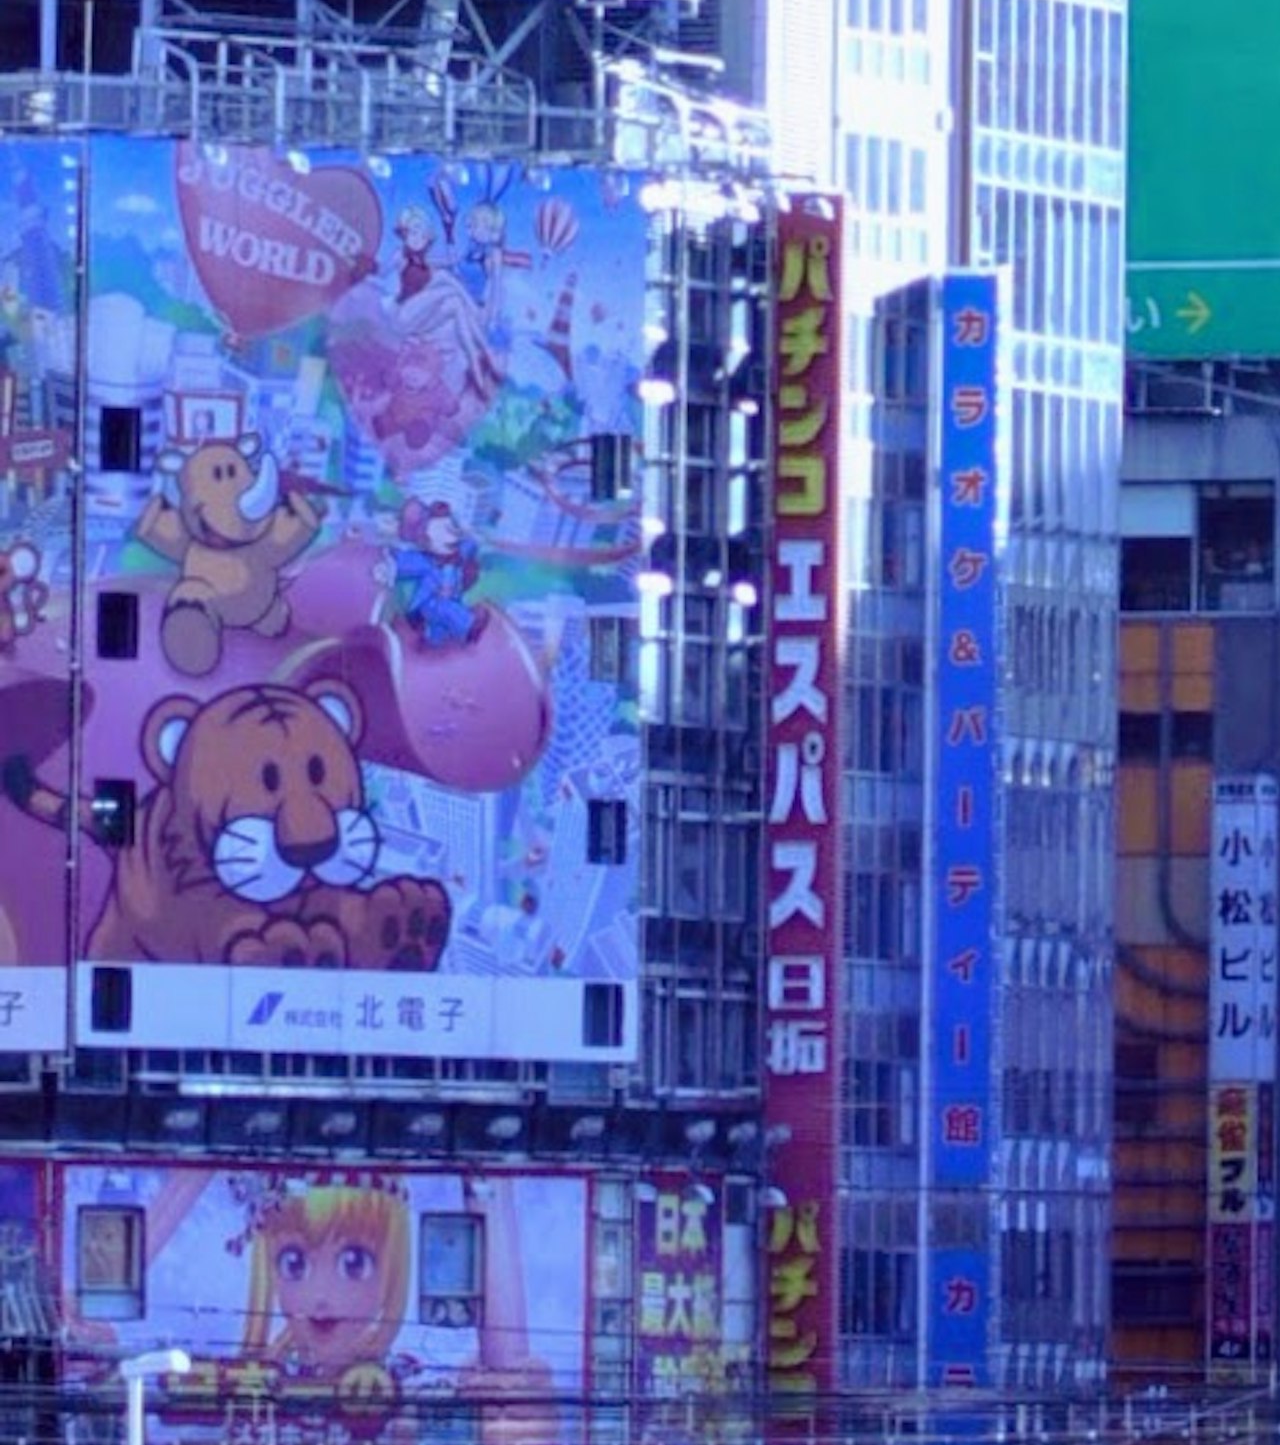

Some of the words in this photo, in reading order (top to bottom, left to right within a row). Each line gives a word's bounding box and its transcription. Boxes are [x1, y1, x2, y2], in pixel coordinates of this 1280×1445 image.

[199, 216, 335, 286] WORLD
[776, 234, 831, 514] パチンコ
[769, 538, 828, 930] エスパス
[356, 993, 464, 1033] 北電子
[1217, 827, 1253, 1040] 小松ビル
